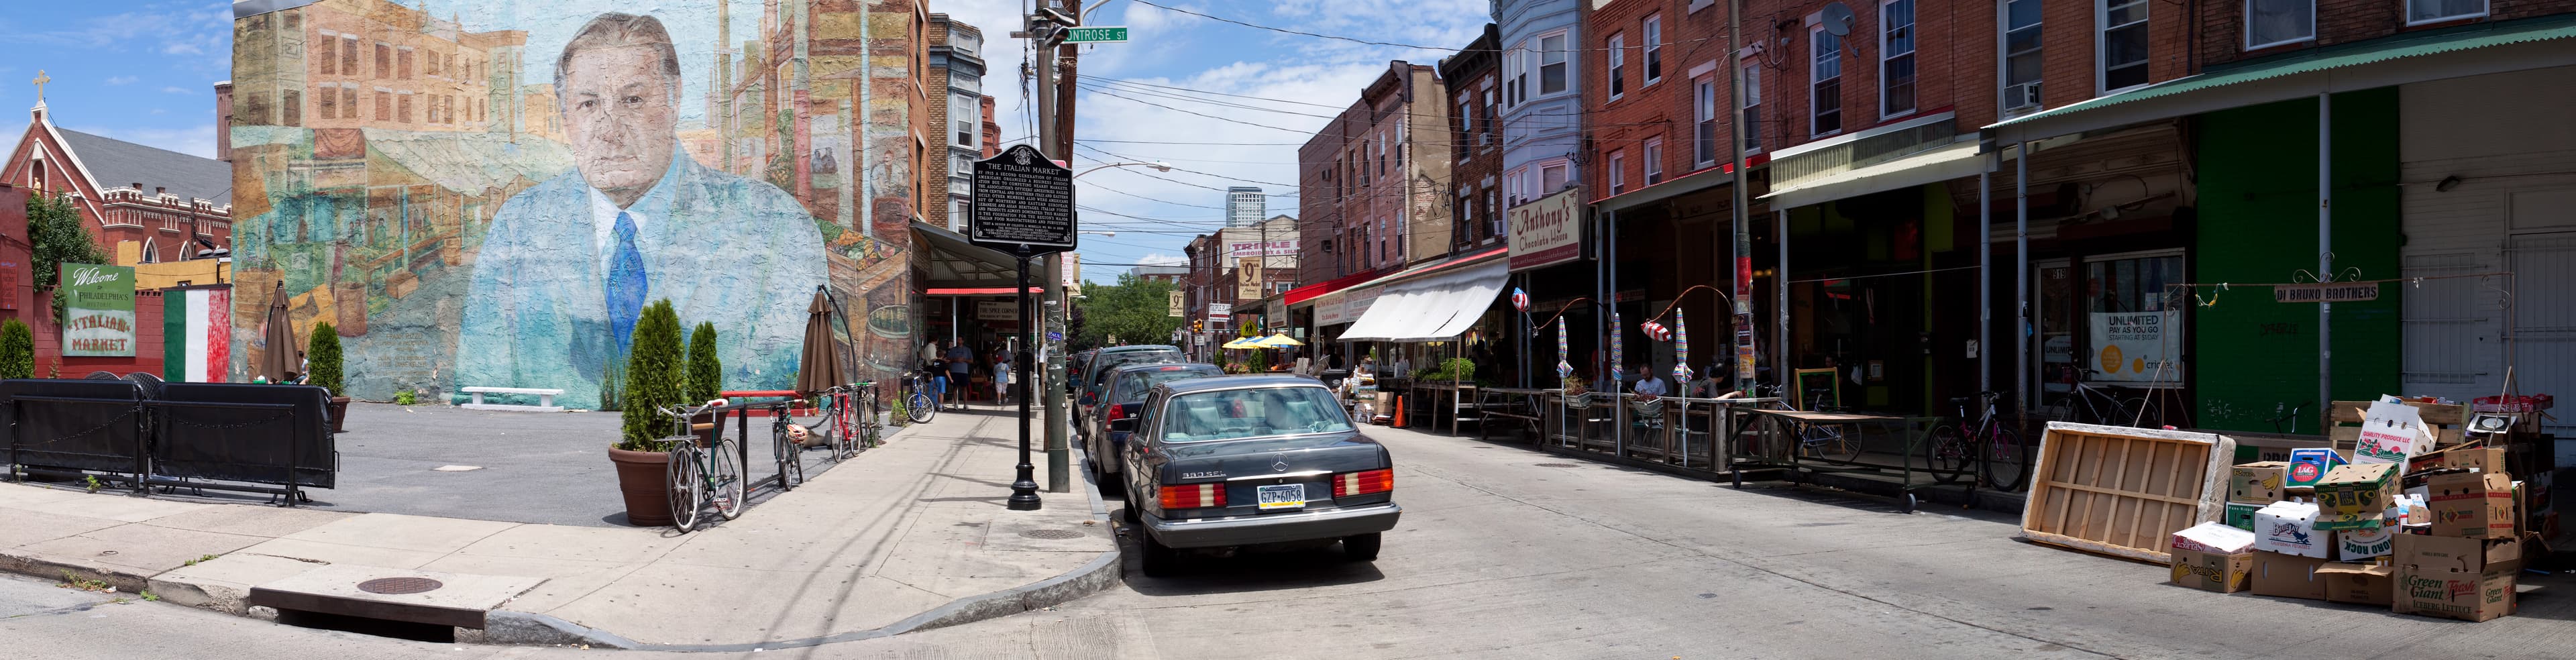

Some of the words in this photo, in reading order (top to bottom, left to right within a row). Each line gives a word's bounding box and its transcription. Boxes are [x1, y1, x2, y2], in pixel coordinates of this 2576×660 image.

[1067, 29, 1111, 41] ONTROSE
[1117, 32, 1126, 40] ST
[1004, 164, 1030, 172] ITALIAN
[1033, 167, 1061, 175] MARKET
[1517, 197, 1570, 236] Anthony's
[1232, 241, 1290, 250] TRIPLE
[1519, 233, 1548, 252] Chocolate
[1550, 228, 1568, 245] House
[73, 267, 119, 286] Welcome
[2053, 268, 2066, 279] 919
[79, 292, 129, 302] PHILADELPHIA'S
[2277, 289, 2286, 301] DI
[2290, 288, 2320, 300] BRUNO
[2326, 286, 2377, 299] BROTHERS
[72, 315, 127, 333] ITALIAN
[2109, 315, 2159, 326] UNLIMITED
[2147, 360, 2174, 370] cricet
[2381, 433, 2402, 442] PRODUCE
[2345, 541, 2369, 555] ROCK
[2371, 539, 2392, 554] ORO
[2190, 565, 2222, 583] RITA
[2408, 574, 2443, 588] Green
[2446, 580, 2475, 594] Fresh
[2410, 586, 2444, 600] Giant
[2485, 588, 2502, 597] Green
[2486, 594, 2502, 604] Giant
[2413, 600, 2442, 611] ICEBERG
[2442, 603, 2472, 614] LETTUCE
